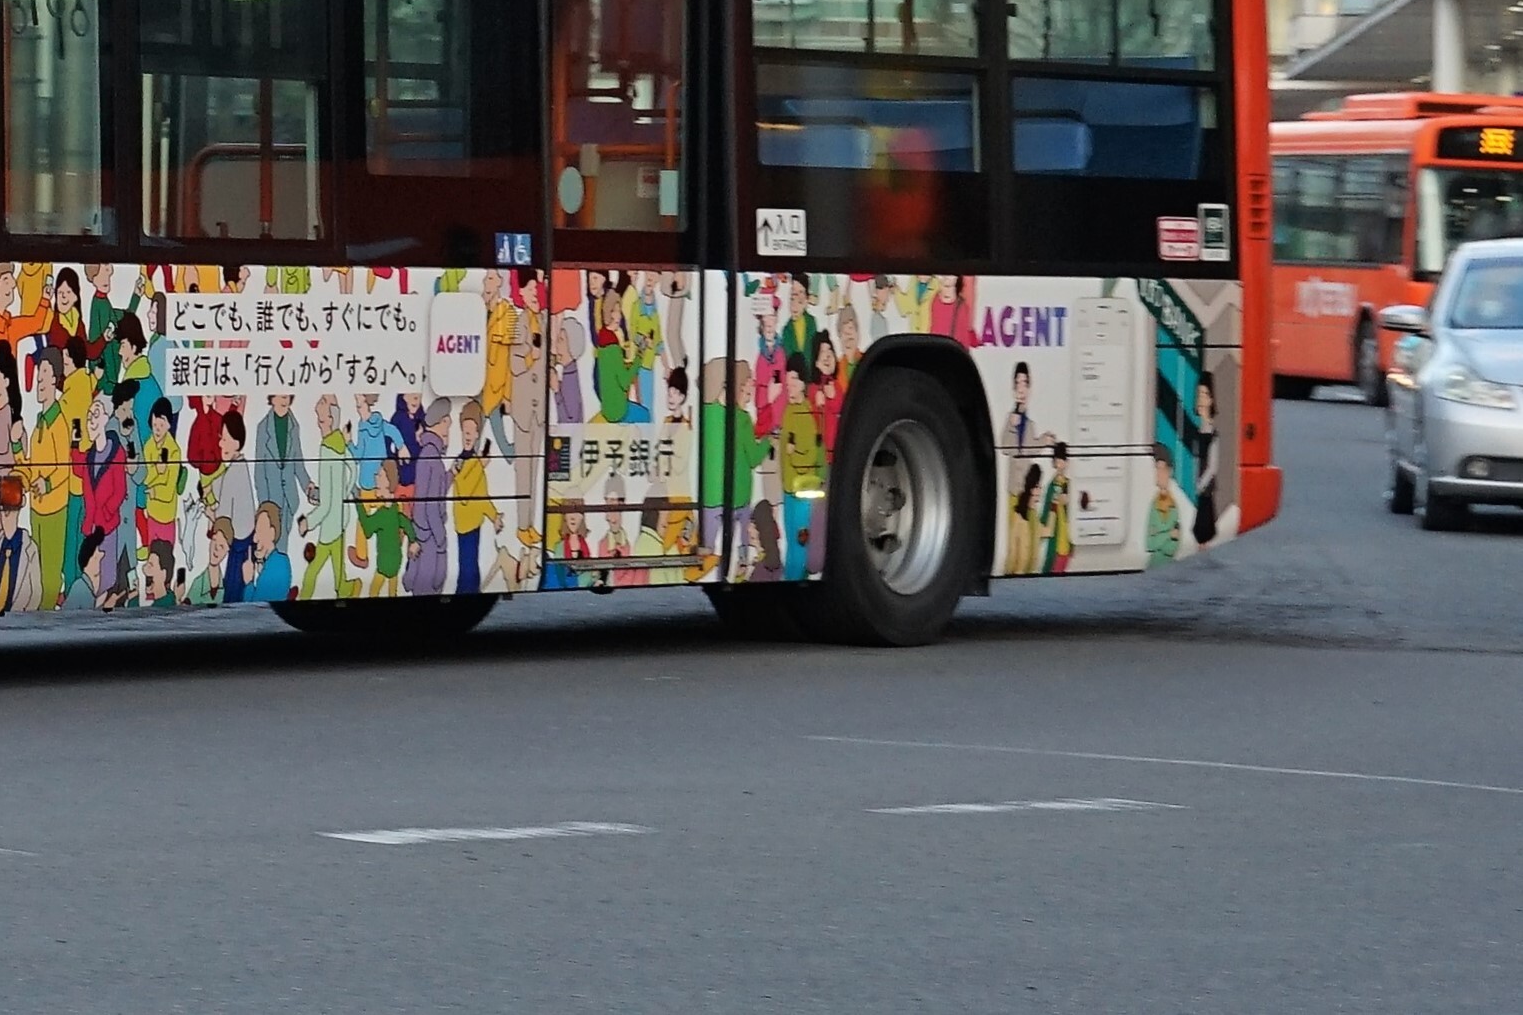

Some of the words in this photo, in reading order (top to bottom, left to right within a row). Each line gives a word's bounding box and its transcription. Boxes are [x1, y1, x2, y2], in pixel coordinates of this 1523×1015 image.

[172, 300, 416, 332] どこでも、誰でも、すぐにでも。
[981, 306, 1067, 347] AGENT
[436, 334, 481, 354] AGENT
[171, 355, 416, 386] 銀行は、「行く」から「する」へ。
[580, 439, 674, 477] 伊予銀行
